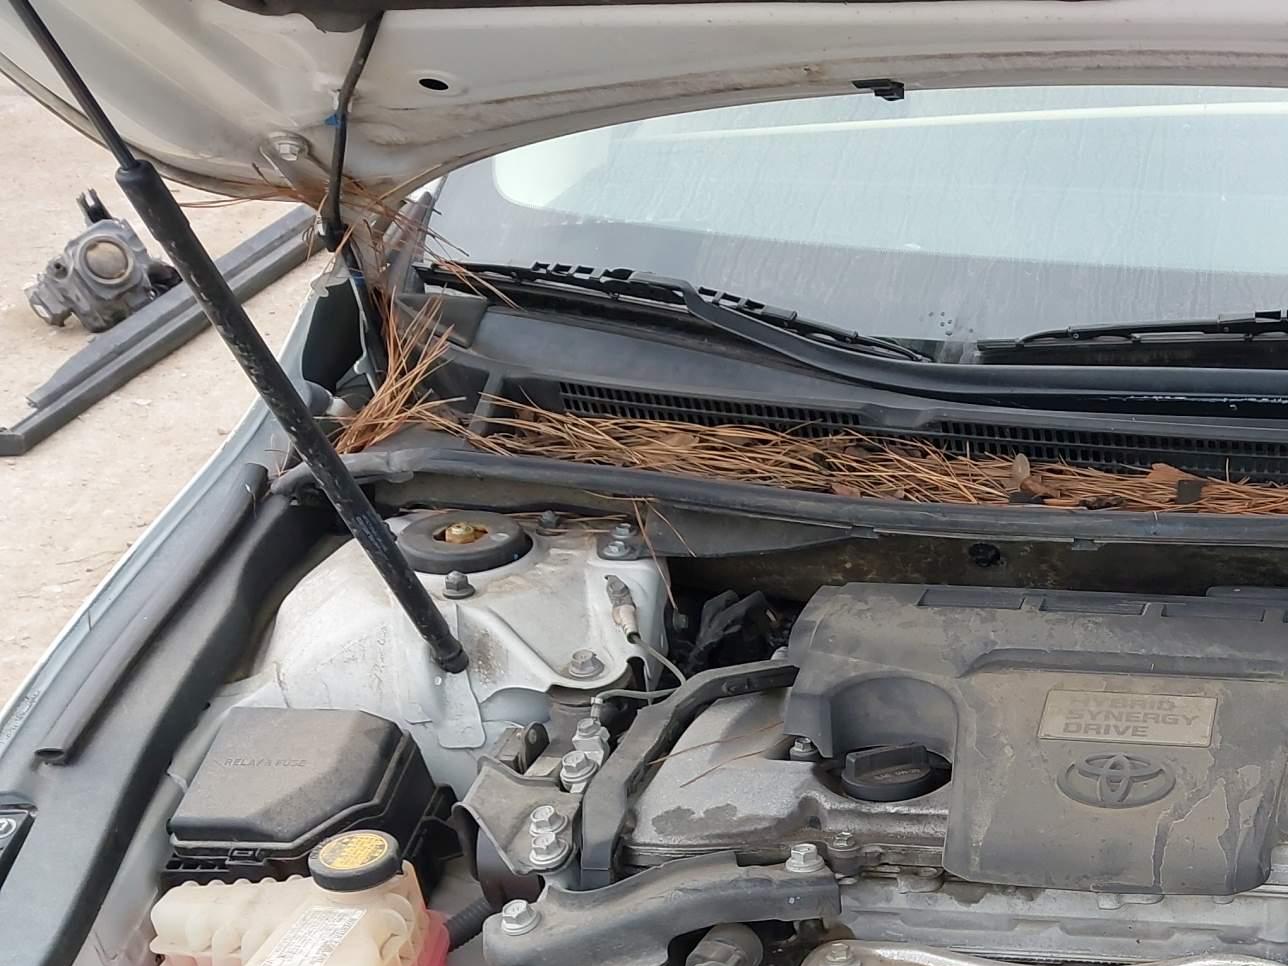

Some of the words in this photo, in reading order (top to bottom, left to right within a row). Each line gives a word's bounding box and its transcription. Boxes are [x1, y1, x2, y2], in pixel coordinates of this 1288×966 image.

[1069, 697, 1175, 713] HYBRID
[1064, 709, 1199, 726] SYNERGY
[1062, 722, 1150, 738] DRIVE
